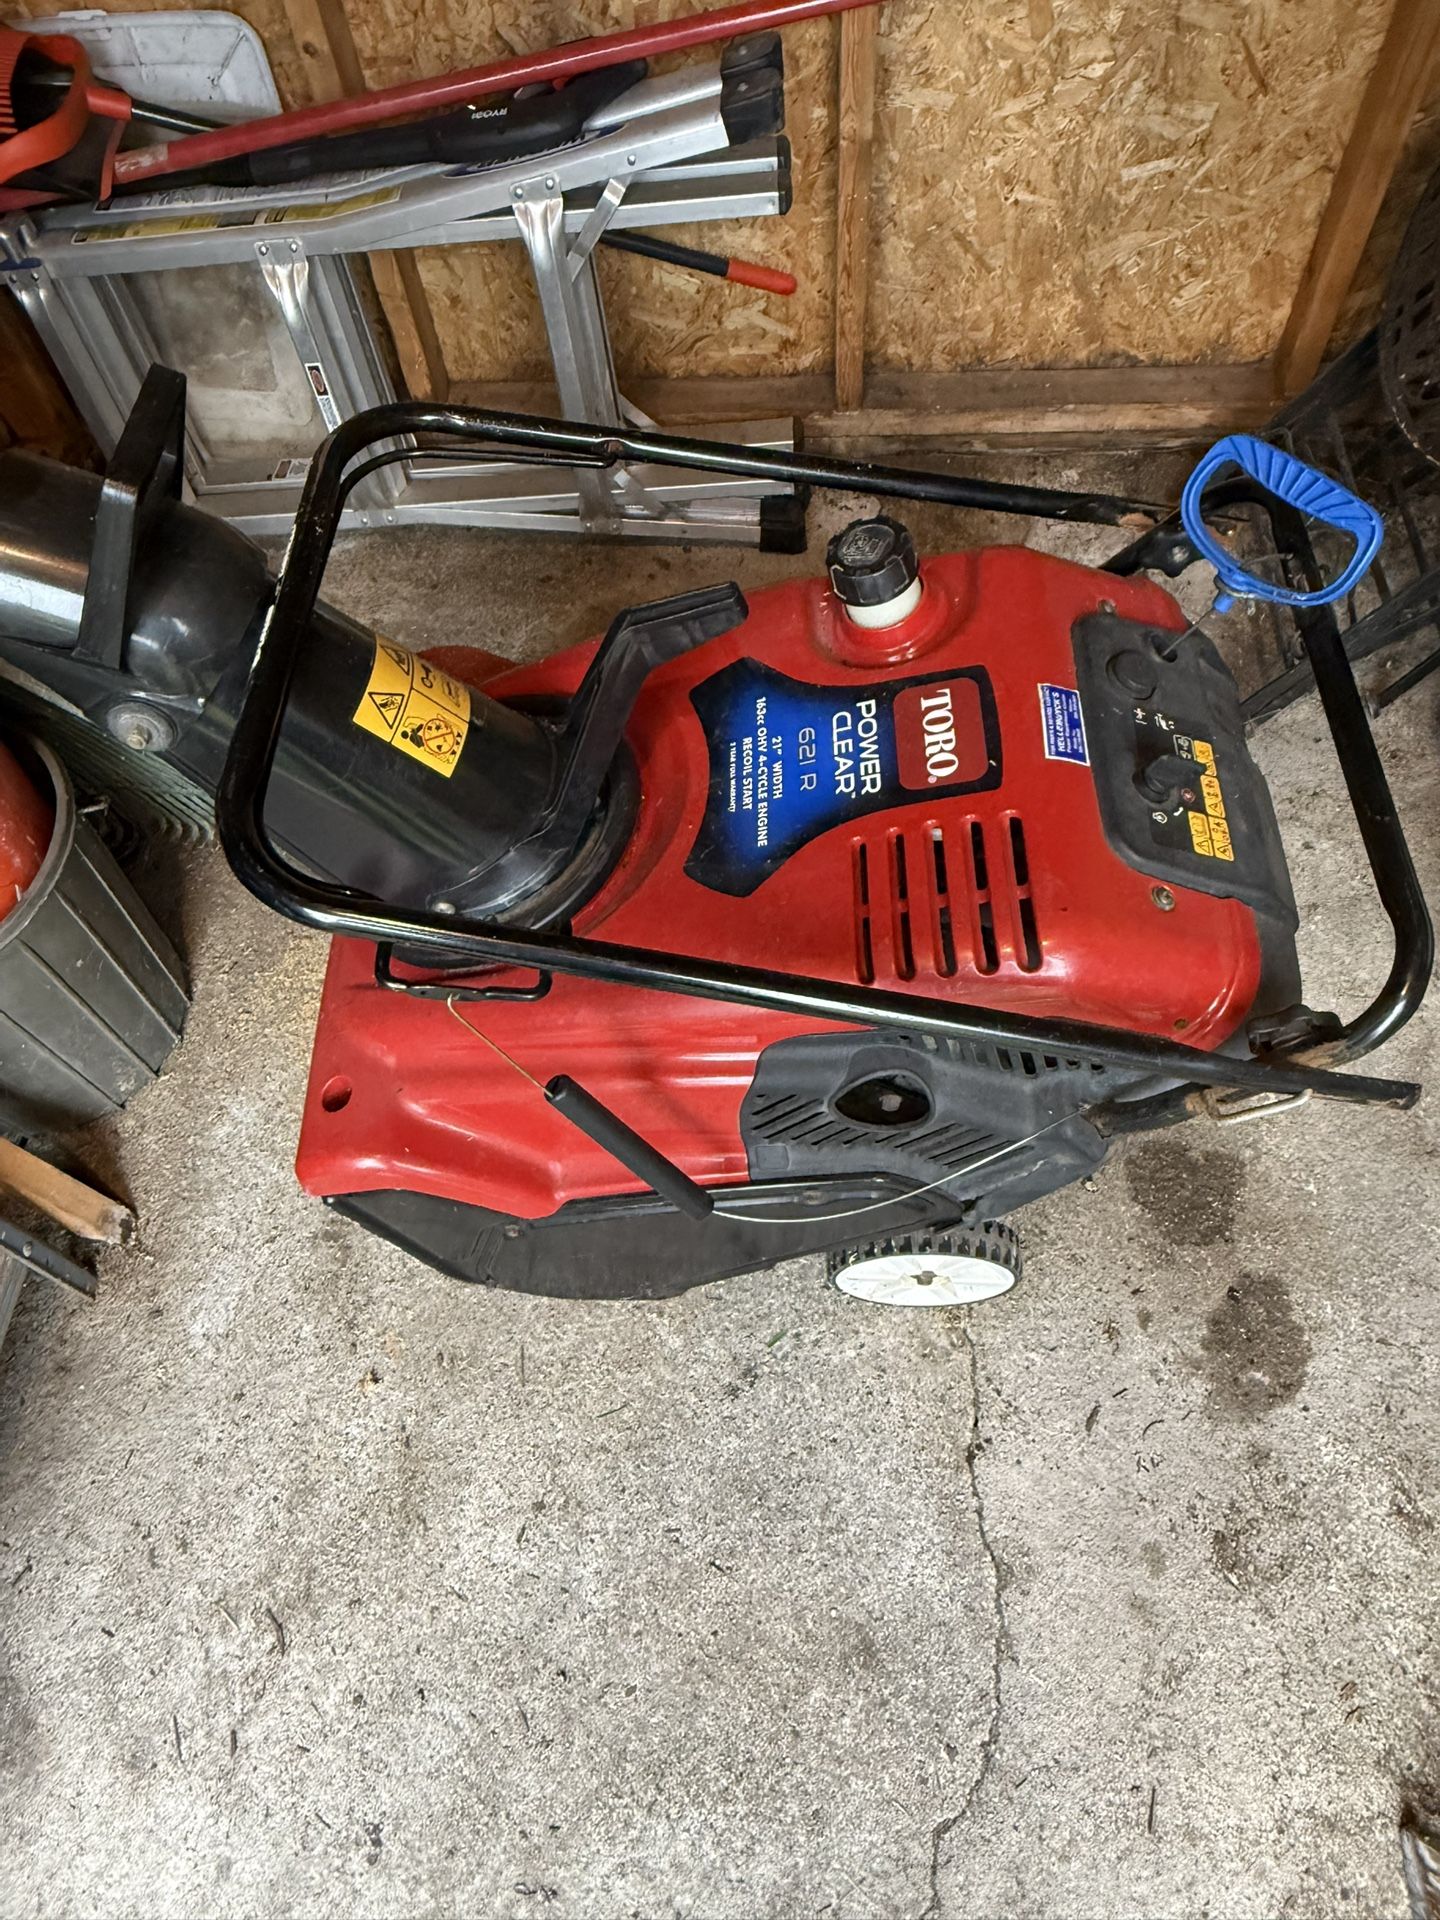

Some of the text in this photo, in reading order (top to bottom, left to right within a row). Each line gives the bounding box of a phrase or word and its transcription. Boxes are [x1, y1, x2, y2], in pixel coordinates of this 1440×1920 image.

[471, 107, 508, 119] RYOBI
[798, 727, 817, 791] 621 R
[856, 699, 881, 795] POWER
[920, 688, 959, 777] TORO
[742, 736, 753, 810] RECOIL START
[756, 696, 768, 847] 163cc OHV 4-CYCLE ENGINE
[772, 760, 783, 799] WIDTH
